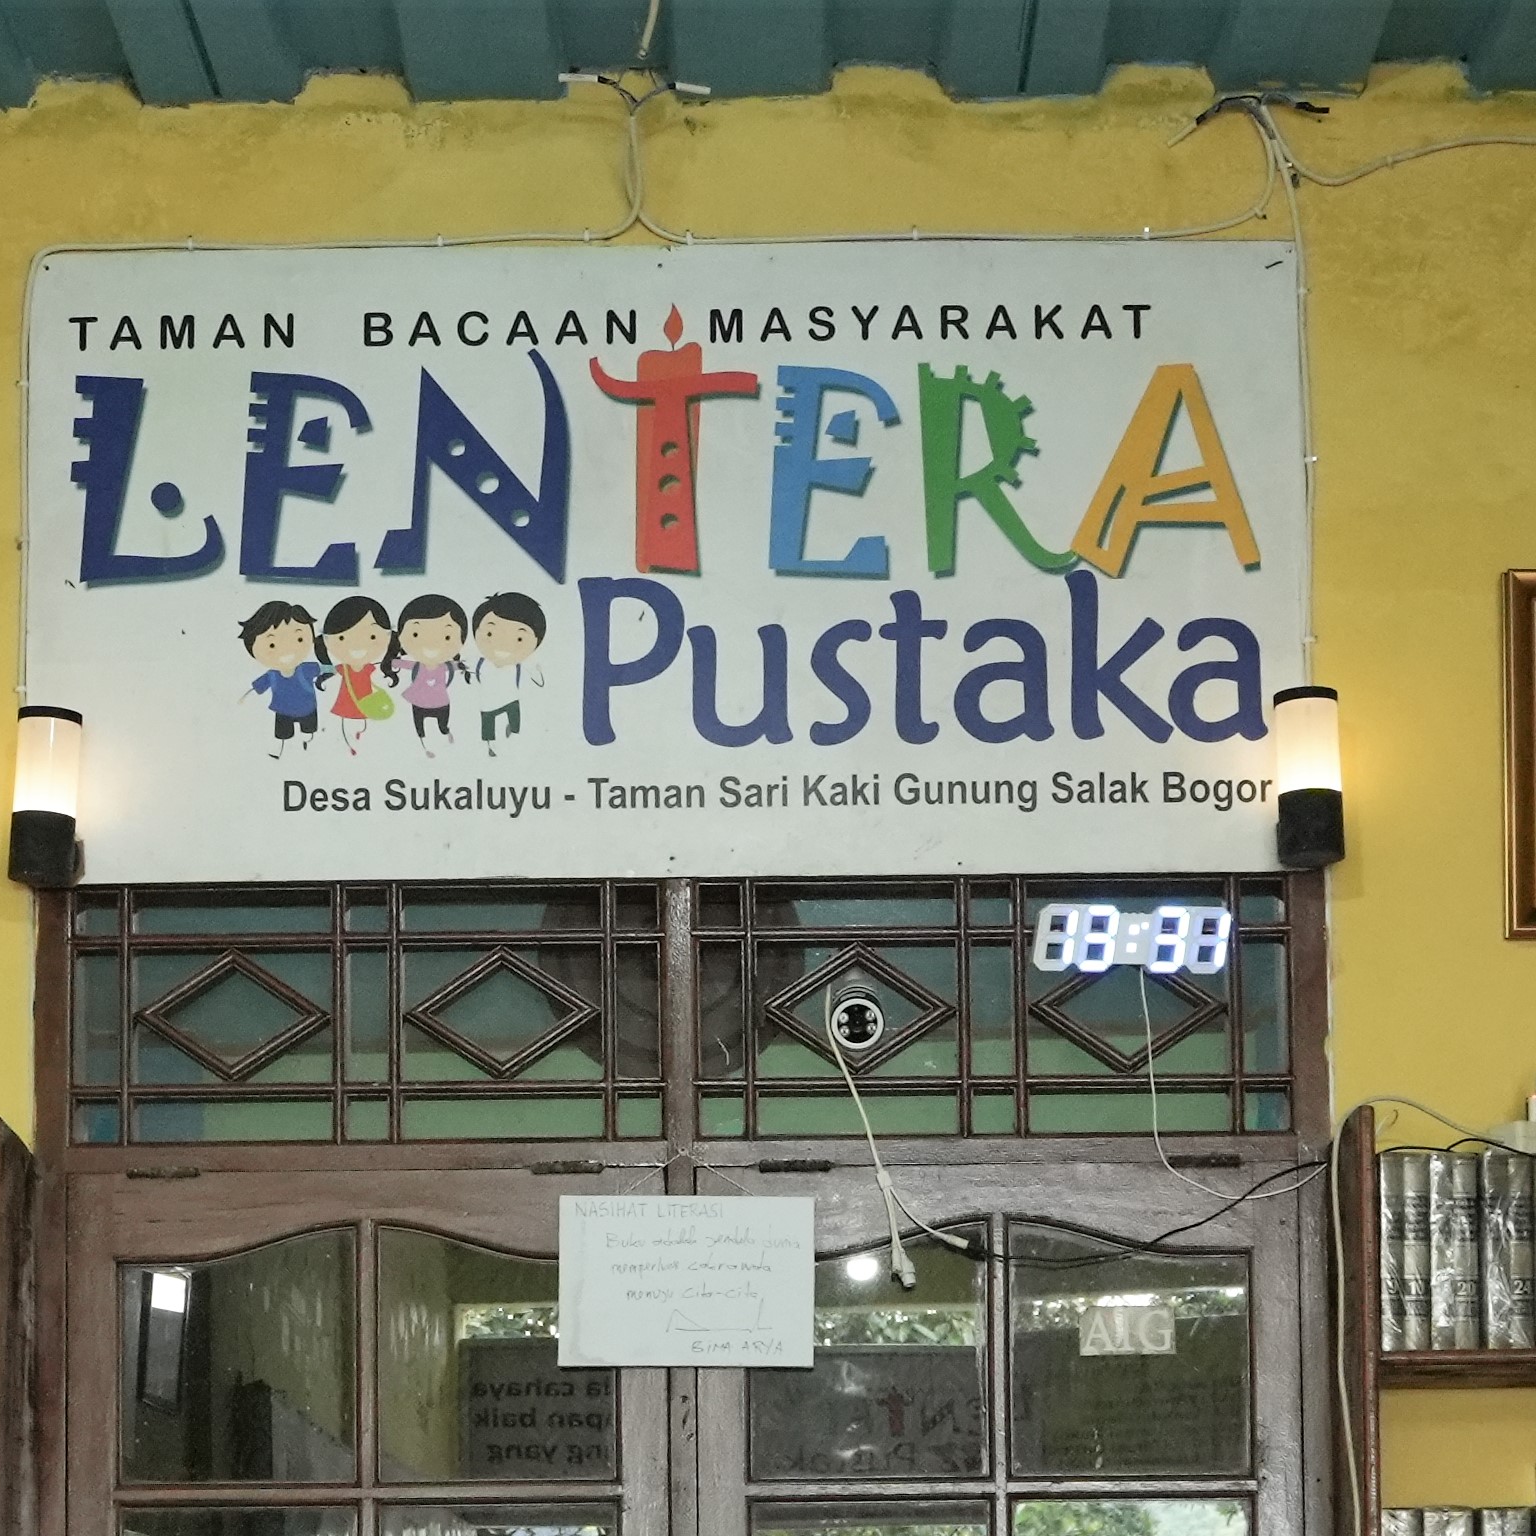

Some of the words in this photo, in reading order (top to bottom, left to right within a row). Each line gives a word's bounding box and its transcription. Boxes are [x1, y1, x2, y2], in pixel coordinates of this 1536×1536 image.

[68, 312, 295, 351] TAMAN
[363, 309, 638, 348] BACAAN
[708, 304, 1152, 344] MASYARAKAT
[69, 345, 1261, 587] LENTERA
[577, 570, 1268, 747] Pustaka
[282, 780, 371, 811] Desa
[383, 778, 552, 818] Sukaluyu
[587, 778, 705, 809] Taman
[718, 775, 788, 808] Sari
[802, 773, 881, 806] Kaki
[893, 773, 1039, 812] Gunung
[1051, 771, 1149, 804] Salak
[1162, 771, 1273, 810] Bogor
[1060, 904, 1232, 973] 13:31
[575, 1202, 648, 1218] NASIHAT
[657, 1202, 724, 1218] LITERASI
[1082, 1310, 1173, 1352] AIG
